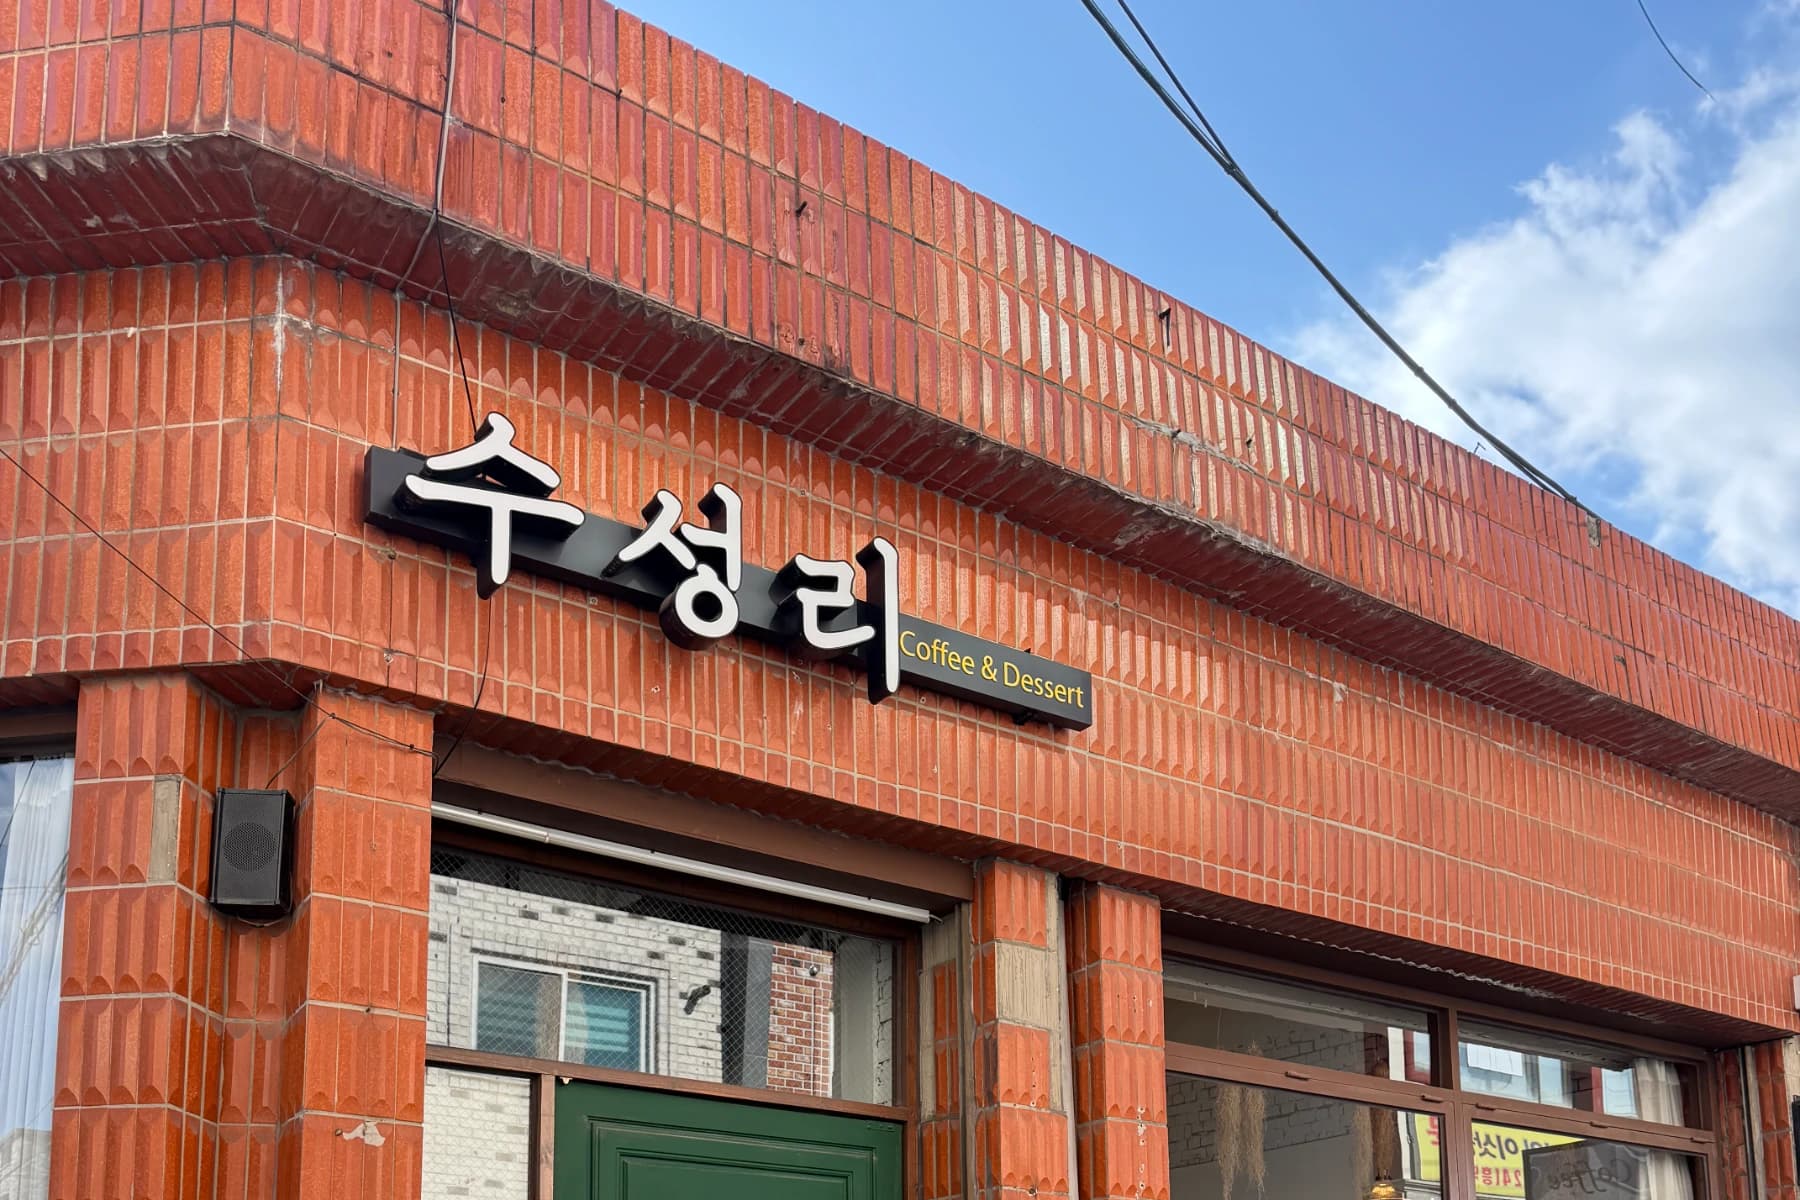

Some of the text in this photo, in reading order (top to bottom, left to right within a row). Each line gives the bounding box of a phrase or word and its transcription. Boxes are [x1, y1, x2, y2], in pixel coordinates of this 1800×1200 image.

[402, 411, 899, 696] 수성리
[900, 630, 1084, 708] Coffee & Dessert
